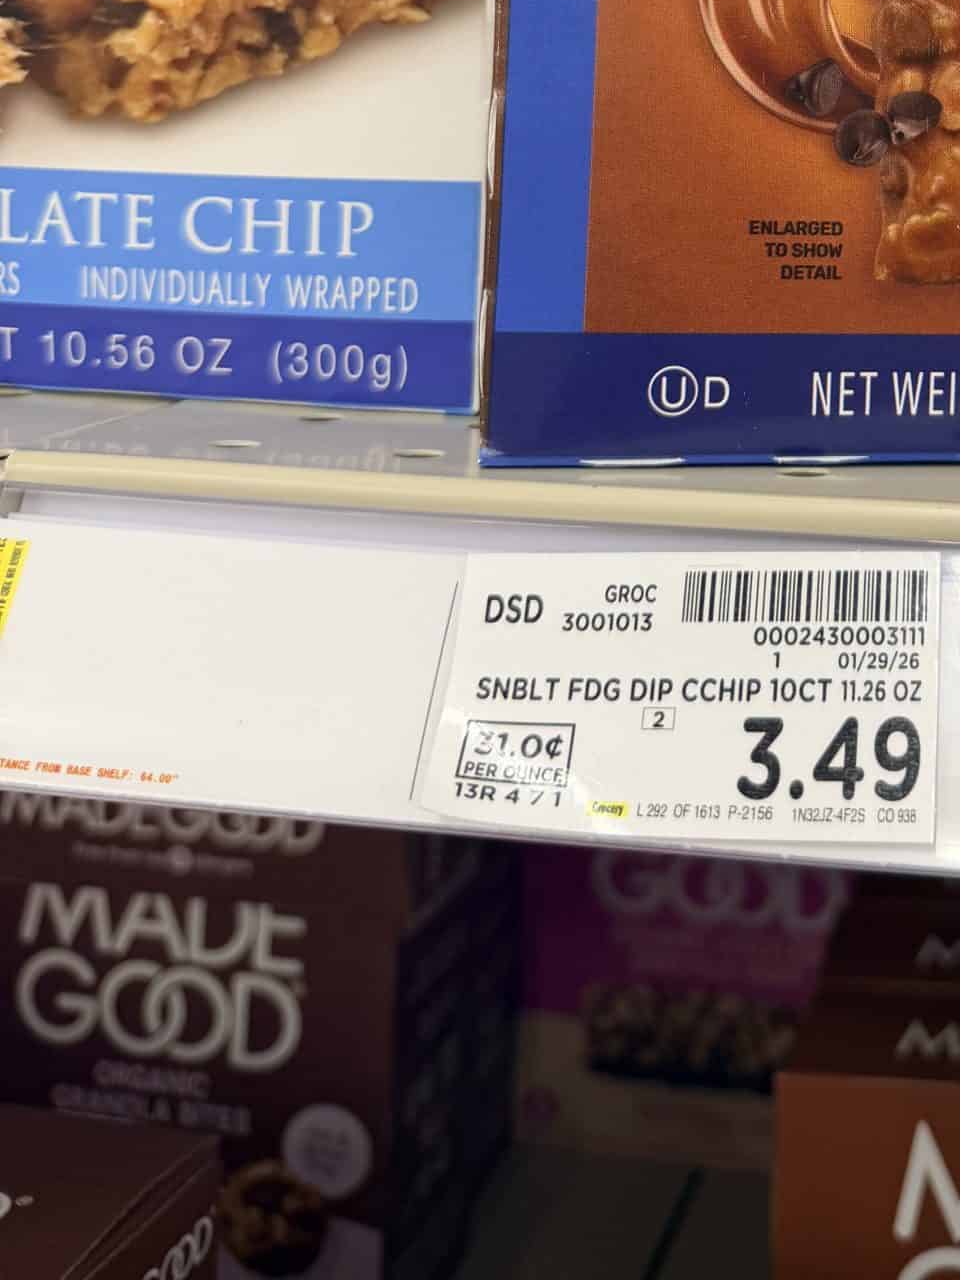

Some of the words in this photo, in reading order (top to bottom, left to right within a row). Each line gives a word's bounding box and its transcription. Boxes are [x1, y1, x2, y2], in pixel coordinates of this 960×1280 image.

[0, 187, 157, 251] LATE
[184, 195, 376, 258] CHIP
[748, 220, 844, 237] ENLARGED
[764, 241, 788, 258] TO
[791, 242, 843, 258] SHOW
[779, 264, 843, 281] DETAIL
[80, 265, 273, 309] INDIVIDUALLY
[285, 274, 420, 314] WRAPPED
[40, 329, 157, 371] 10.56
[176, 335, 234, 375] OZ
[272, 340, 409, 391] (300g)
[810, 370, 876, 418] NET
[604, 583, 658, 605] GROC
[483, 593, 544, 625] DSD
[561, 611, 654, 633] 3001013
[753, 625, 927, 648] 0002430003111
[772, 651, 781, 670] 1
[837, 650, 921, 672] 01/29/26
[475, 677, 561, 704] SNBLT
[566, 677, 622, 703] FDG
[628, 677, 674, 703] DIP
[681, 677, 762, 704] CCHIP
[769, 677, 833, 704] 10CT
[840, 679, 888, 703] 11.26
[893, 680, 923, 703] OZ
[653, 711, 666, 729] 2
[35, 761, 63, 774] FROM
[66, 764, 93, 777] BASE
[463, 760, 499, 778] PER
[736, 715, 923, 803] 3.49
[454, 781, 498, 802] 13R
[504, 788, 521, 805] 4
[553, 791, 562, 808] 1
[646, 803, 668, 819] 292
[673, 803, 691, 819] OF
[695, 804, 721, 820] 1613
[727, 805, 774, 821] P-2156
[876, 808, 895, 824] CO
[18, 881, 308, 978] MADE
[15, 947, 304, 1073] GOOD
